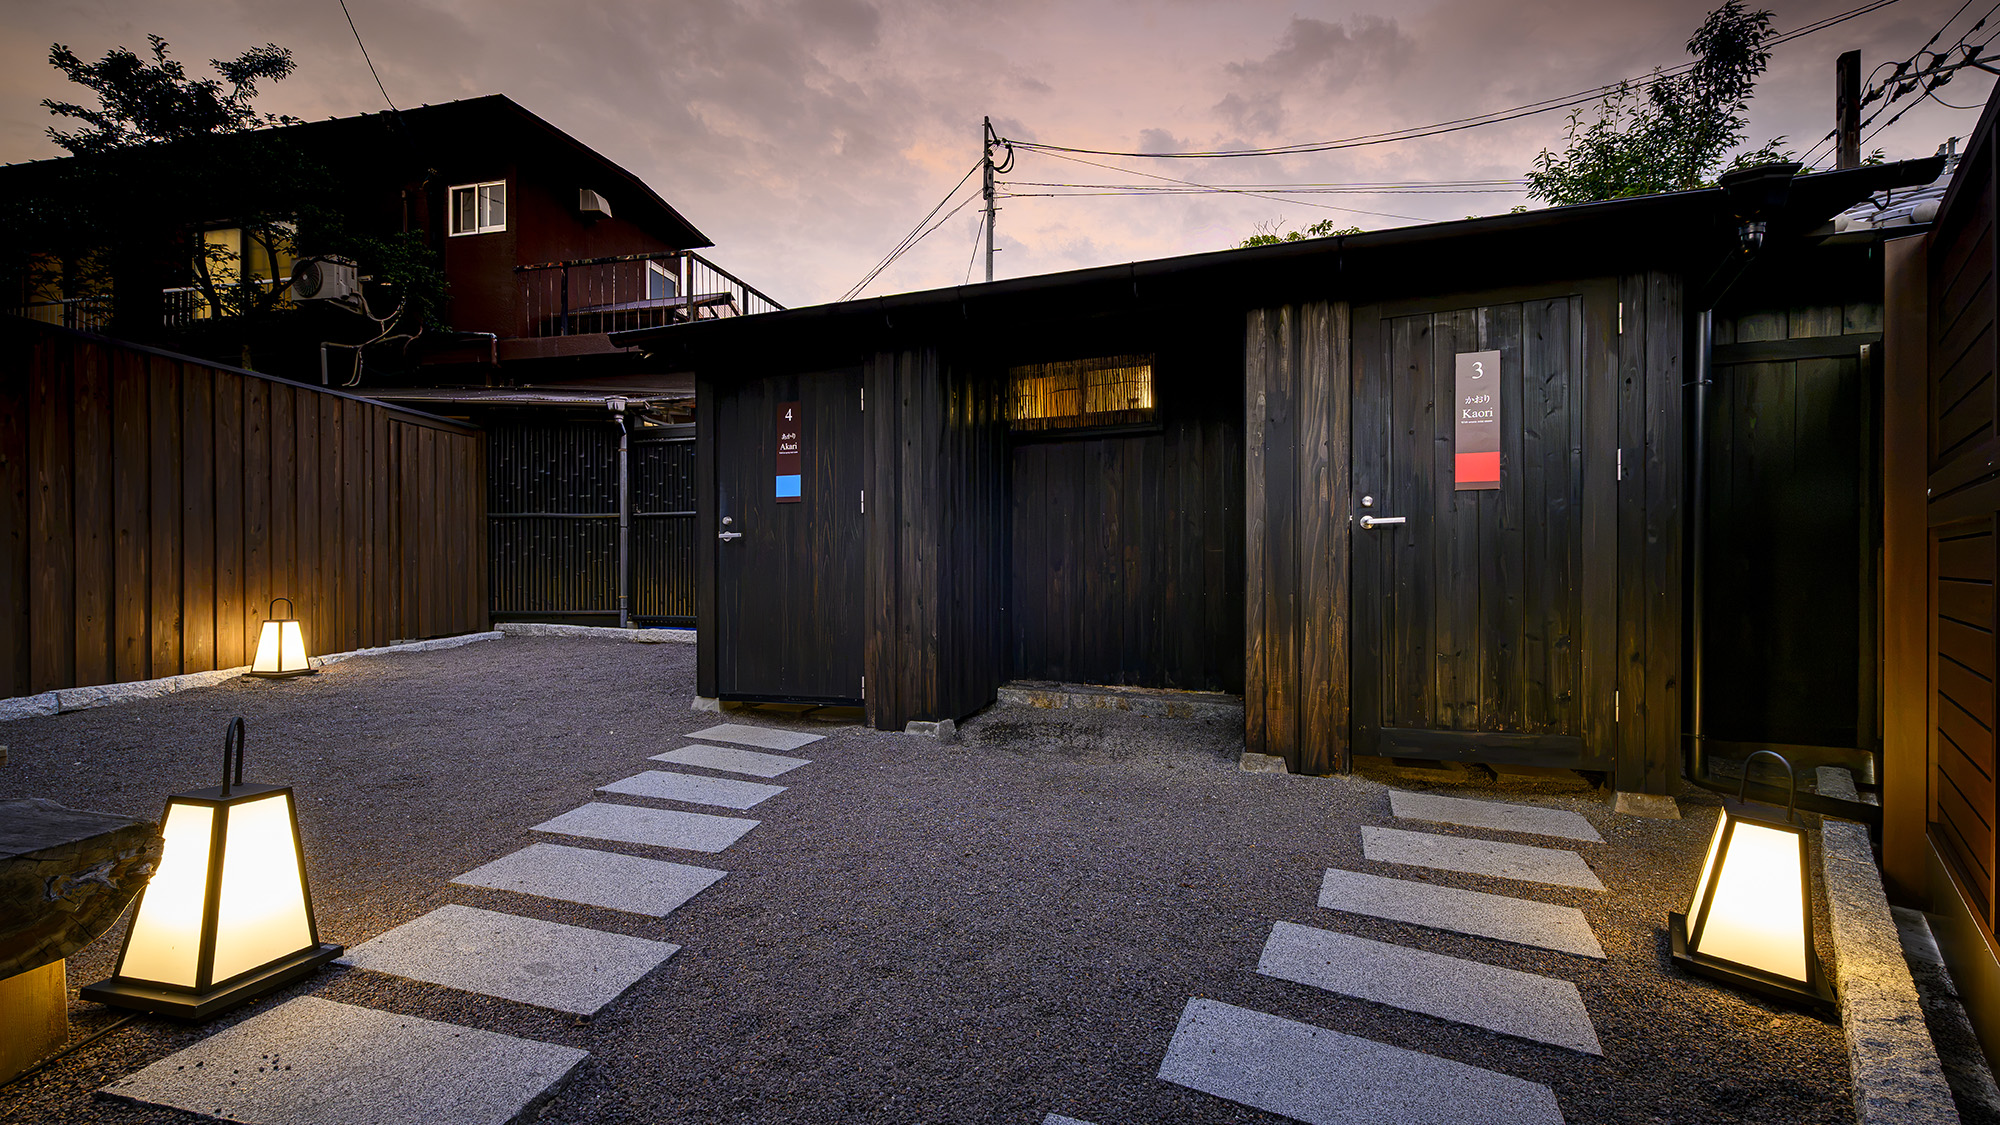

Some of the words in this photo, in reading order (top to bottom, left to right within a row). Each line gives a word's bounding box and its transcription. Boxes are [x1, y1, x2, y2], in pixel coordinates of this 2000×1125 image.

[1471, 361, 1484, 379] 3
[1464, 394, 1490, 405] かおり
[784, 408, 793, 422] 4
[1462, 407, 1493, 419] Kaori
[780, 442, 798, 451] Akari
